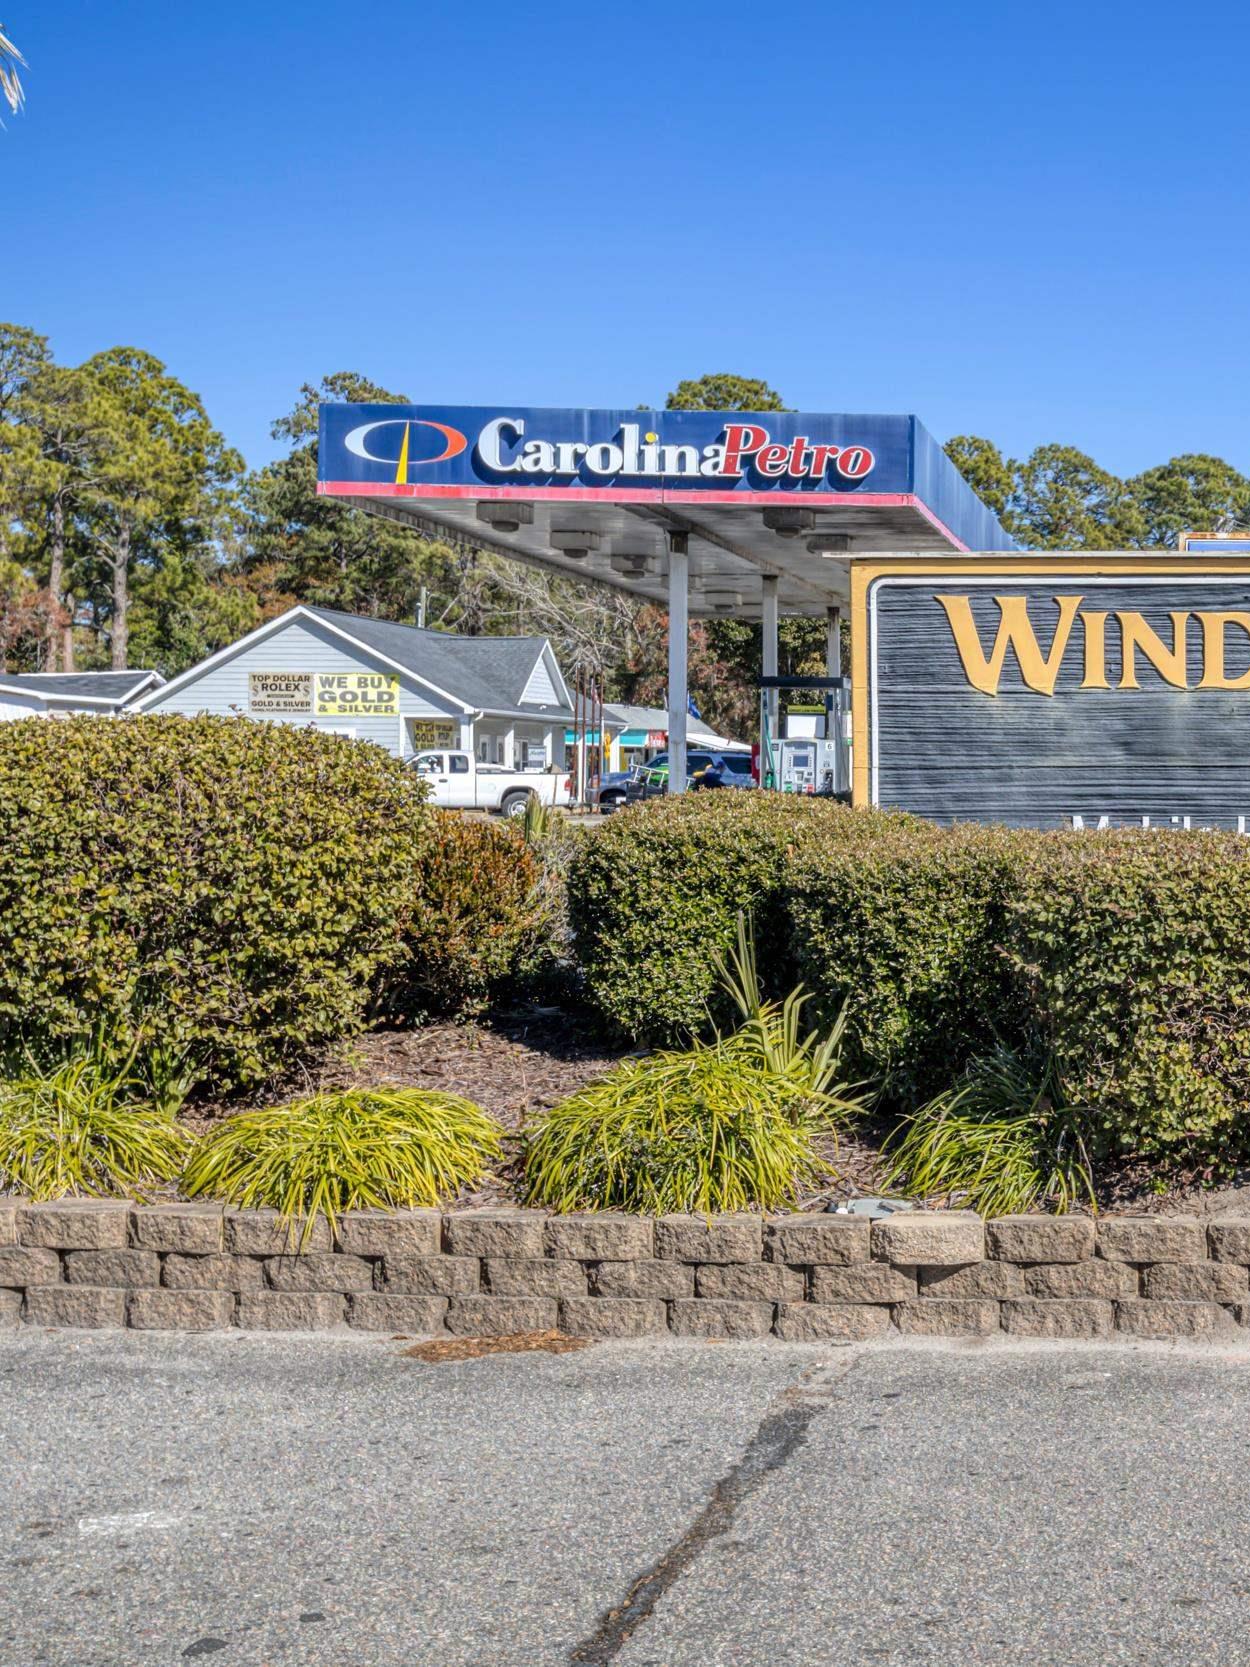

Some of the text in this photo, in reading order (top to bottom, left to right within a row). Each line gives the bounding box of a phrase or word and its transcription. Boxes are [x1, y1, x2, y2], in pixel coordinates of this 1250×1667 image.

[261, 683, 301, 691] ROLEX
[319, 676, 395, 688] WE BUY
[318, 691, 395, 703] GOLD
[318, 705, 328, 713] &
[338, 705, 395, 713] SILVER
[415, 733, 435, 743] GOLD
